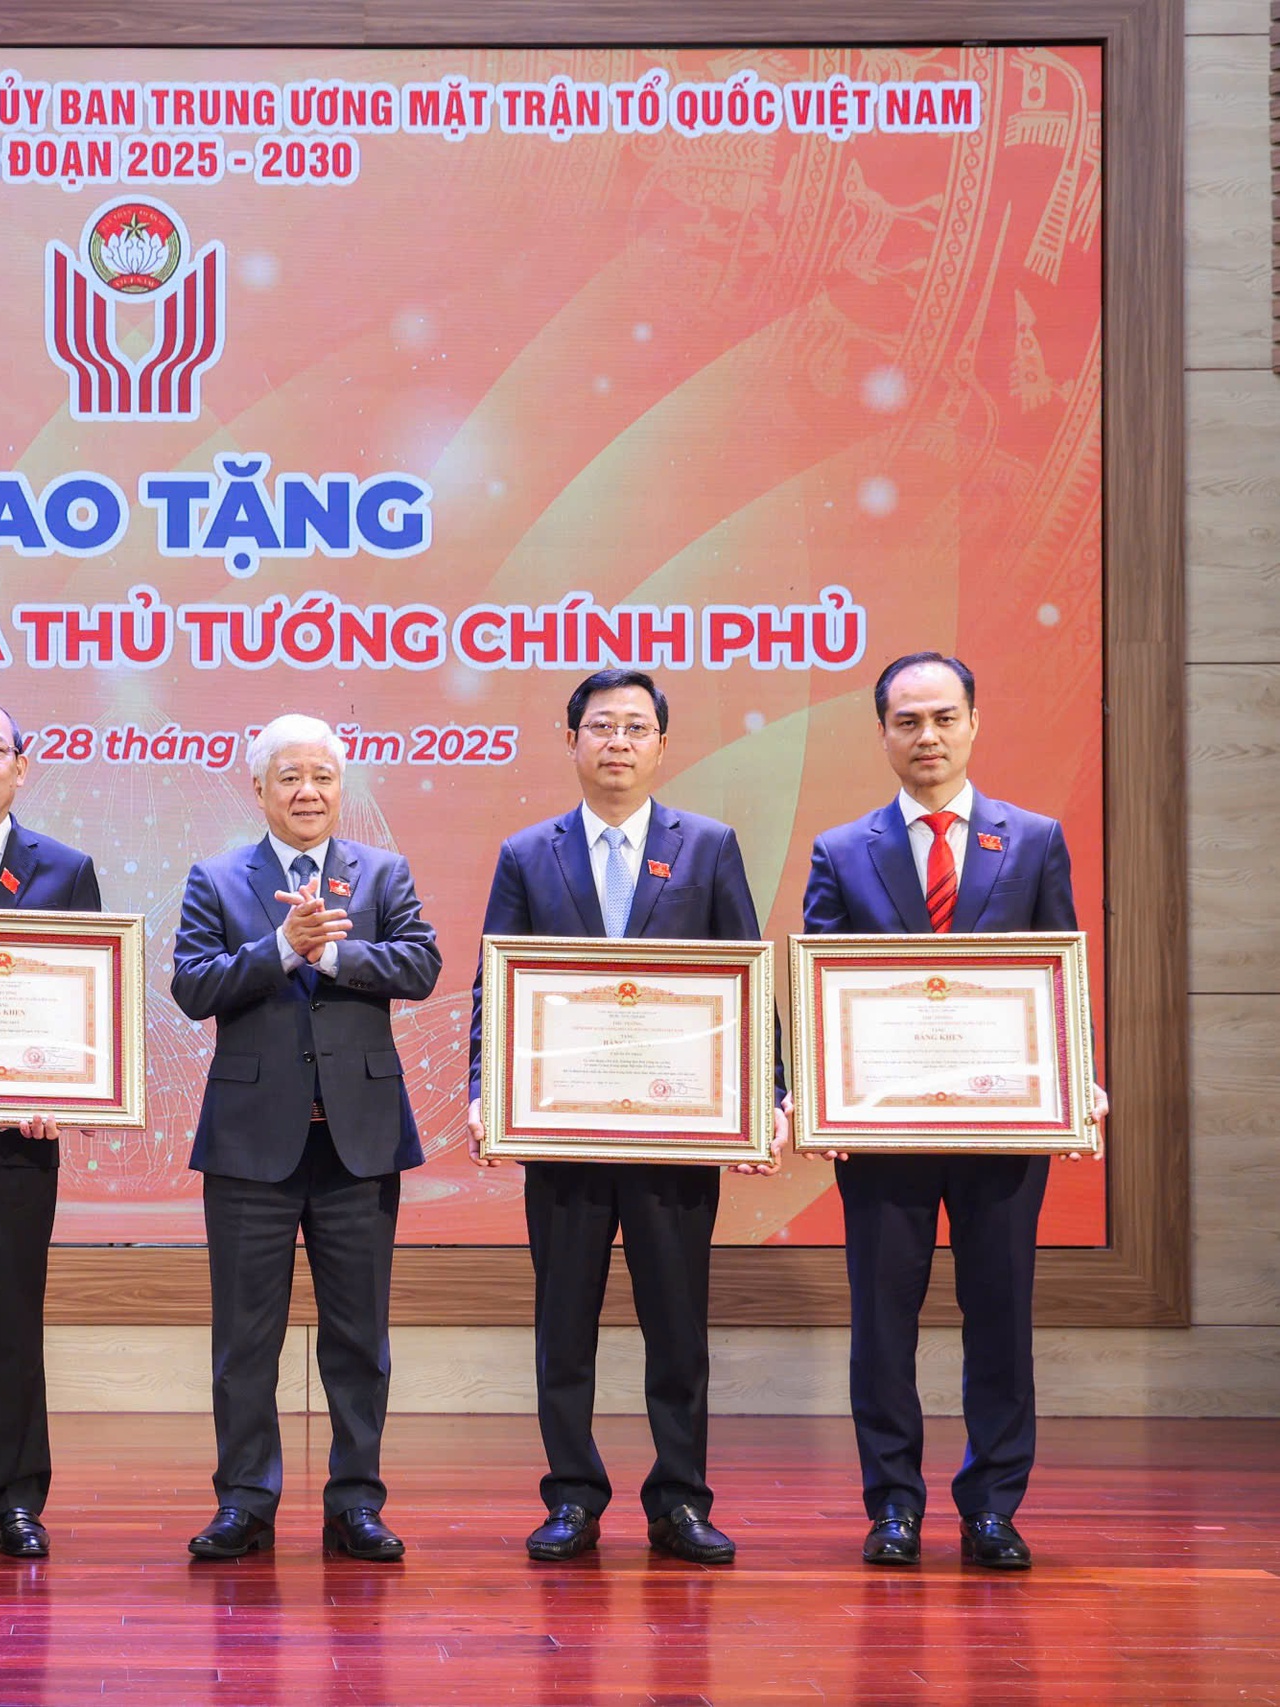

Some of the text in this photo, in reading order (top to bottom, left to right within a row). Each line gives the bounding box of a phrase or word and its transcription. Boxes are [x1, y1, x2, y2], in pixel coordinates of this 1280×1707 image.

[60, 89, 136, 124] BAN
[151, 90, 275, 125] TRUNG
[290, 87, 393, 126] ƯƠNG
[409, 82, 488, 134] MẶT
[503, 82, 600, 134] TRẬN
[616, 75, 661, 126] TỔ
[676, 76, 776, 130] QUỐC
[791, 82, 871, 133] VIỆT
[886, 89, 973, 125] NAM
[8, 141, 112, 185] ĐOẠN
[127, 142, 218, 177] 2025
[262, 142, 352, 178] 2030
[145, 459, 427, 573] TẶNG
[20, 592, 166, 662] THỦ
[184, 599, 439, 663] TƯỚNG
[460, 599, 686, 663] CHÍNH
[710, 593, 859, 663] PHỦ
[41, 729, 94, 760] 28
[106, 727, 235, 768] tháng
[341, 728, 401, 761] ăm
[412, 729, 514, 761] 2025
